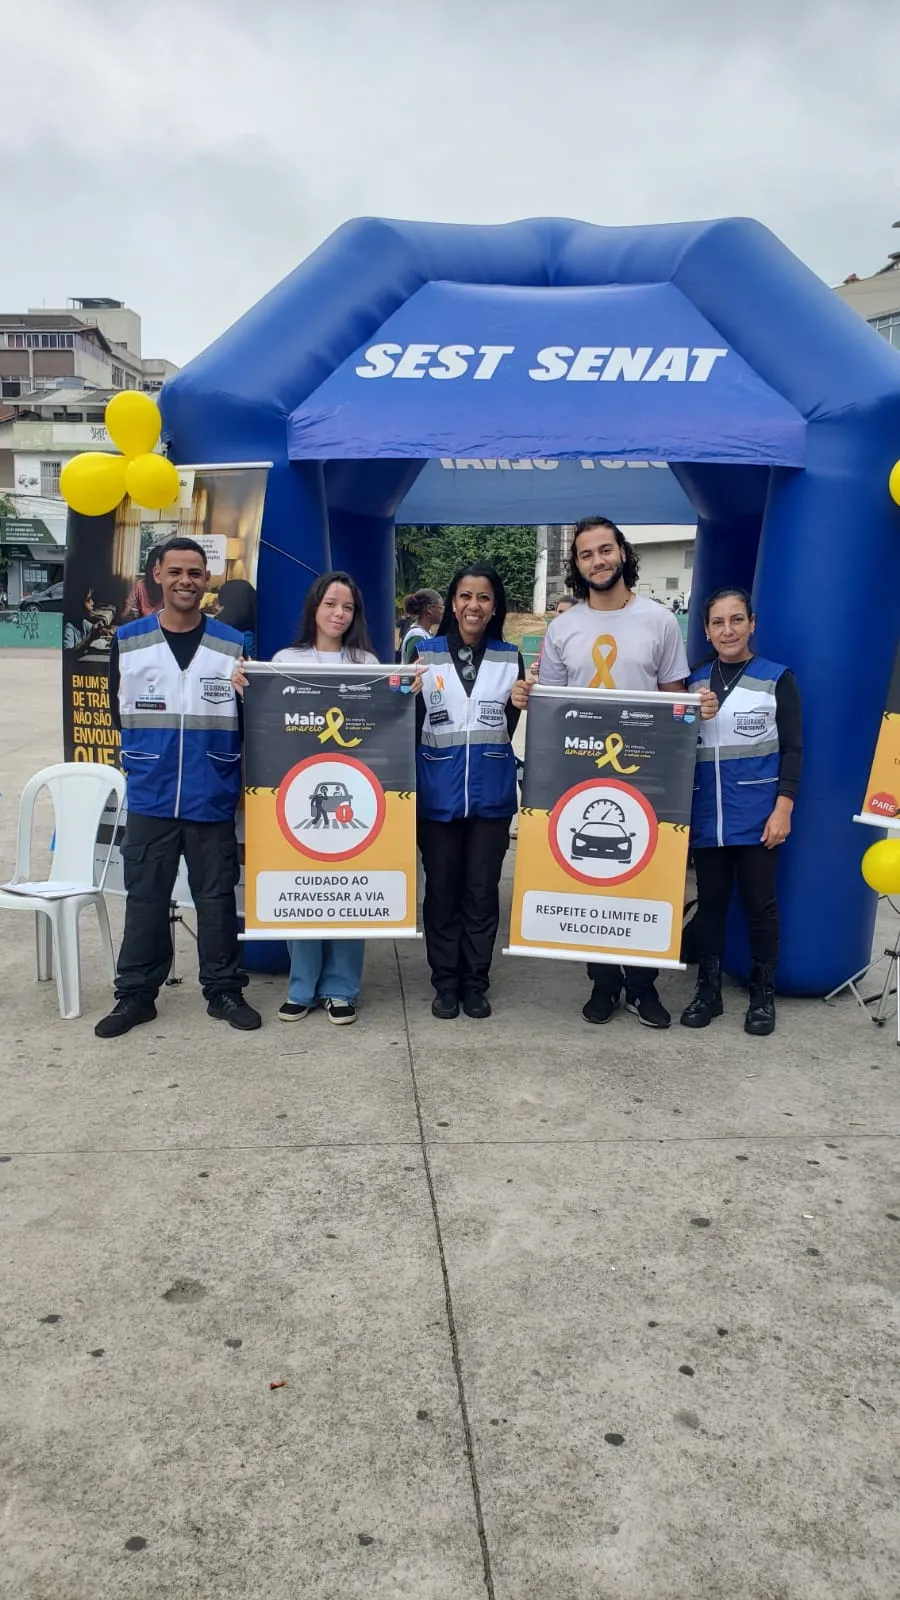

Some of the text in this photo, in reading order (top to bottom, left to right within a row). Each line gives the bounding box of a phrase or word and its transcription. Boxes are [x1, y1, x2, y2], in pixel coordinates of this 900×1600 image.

[355, 343, 729, 382] SEST SENAT
[72, 674, 84, 688] EM
[85, 675, 99, 689] UM
[73, 691, 85, 707] DE
[73, 707, 112, 726] NÃO SÃO
[284, 711, 326, 725] Maio
[564, 736, 604, 750] Maio
[871, 799, 895, 813] PARE
[294, 876, 369, 886] CUIDADO AO
[278, 892, 385, 902] ATRAVESSAR A VIA
[273, 907, 390, 917] USANDO O CELULAR
[535, 904, 658, 923] RESPEITE O LIMITE DE
[559, 922, 632, 937] VELOCIDADE
